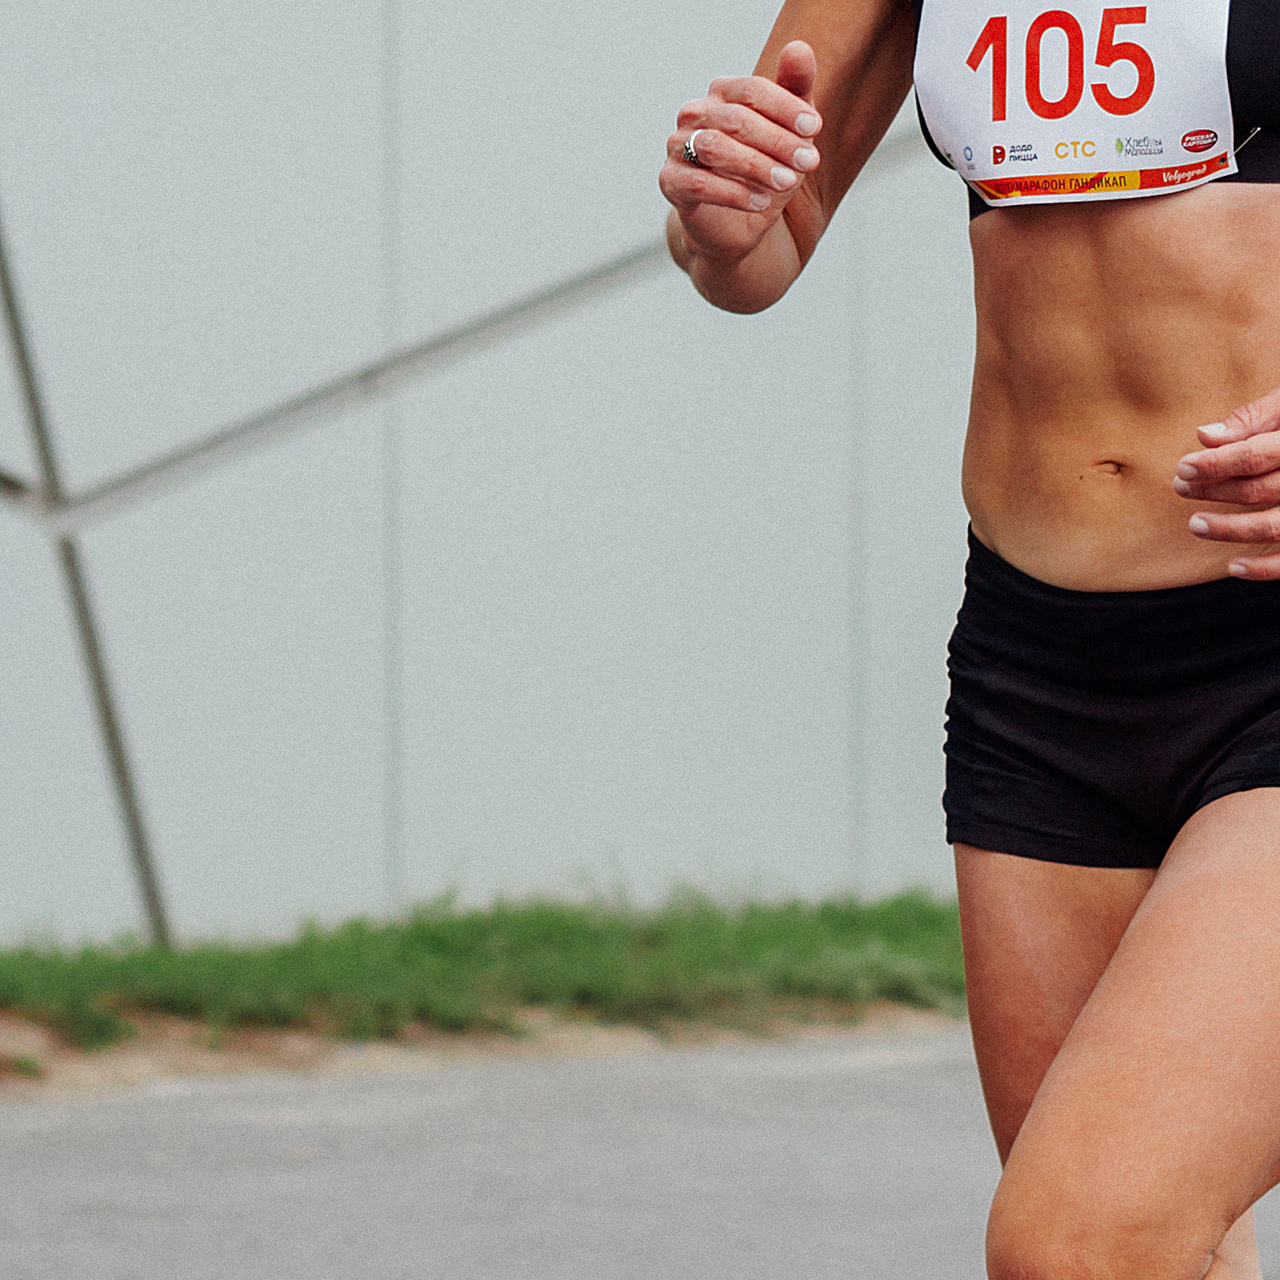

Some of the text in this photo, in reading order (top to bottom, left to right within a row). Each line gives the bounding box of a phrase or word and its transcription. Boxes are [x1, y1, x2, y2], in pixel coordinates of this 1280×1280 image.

[965, 6, 1156, 123] 105
[1009, 145, 1033, 153] ДОДО
[1054, 140, 1097, 160] СТС
[1009, 153, 1038, 162] ПИЦЦА
[1069, 175, 1127, 190] ГАНДИКАП
[1163, 166, 1206, 183] Volgograd
